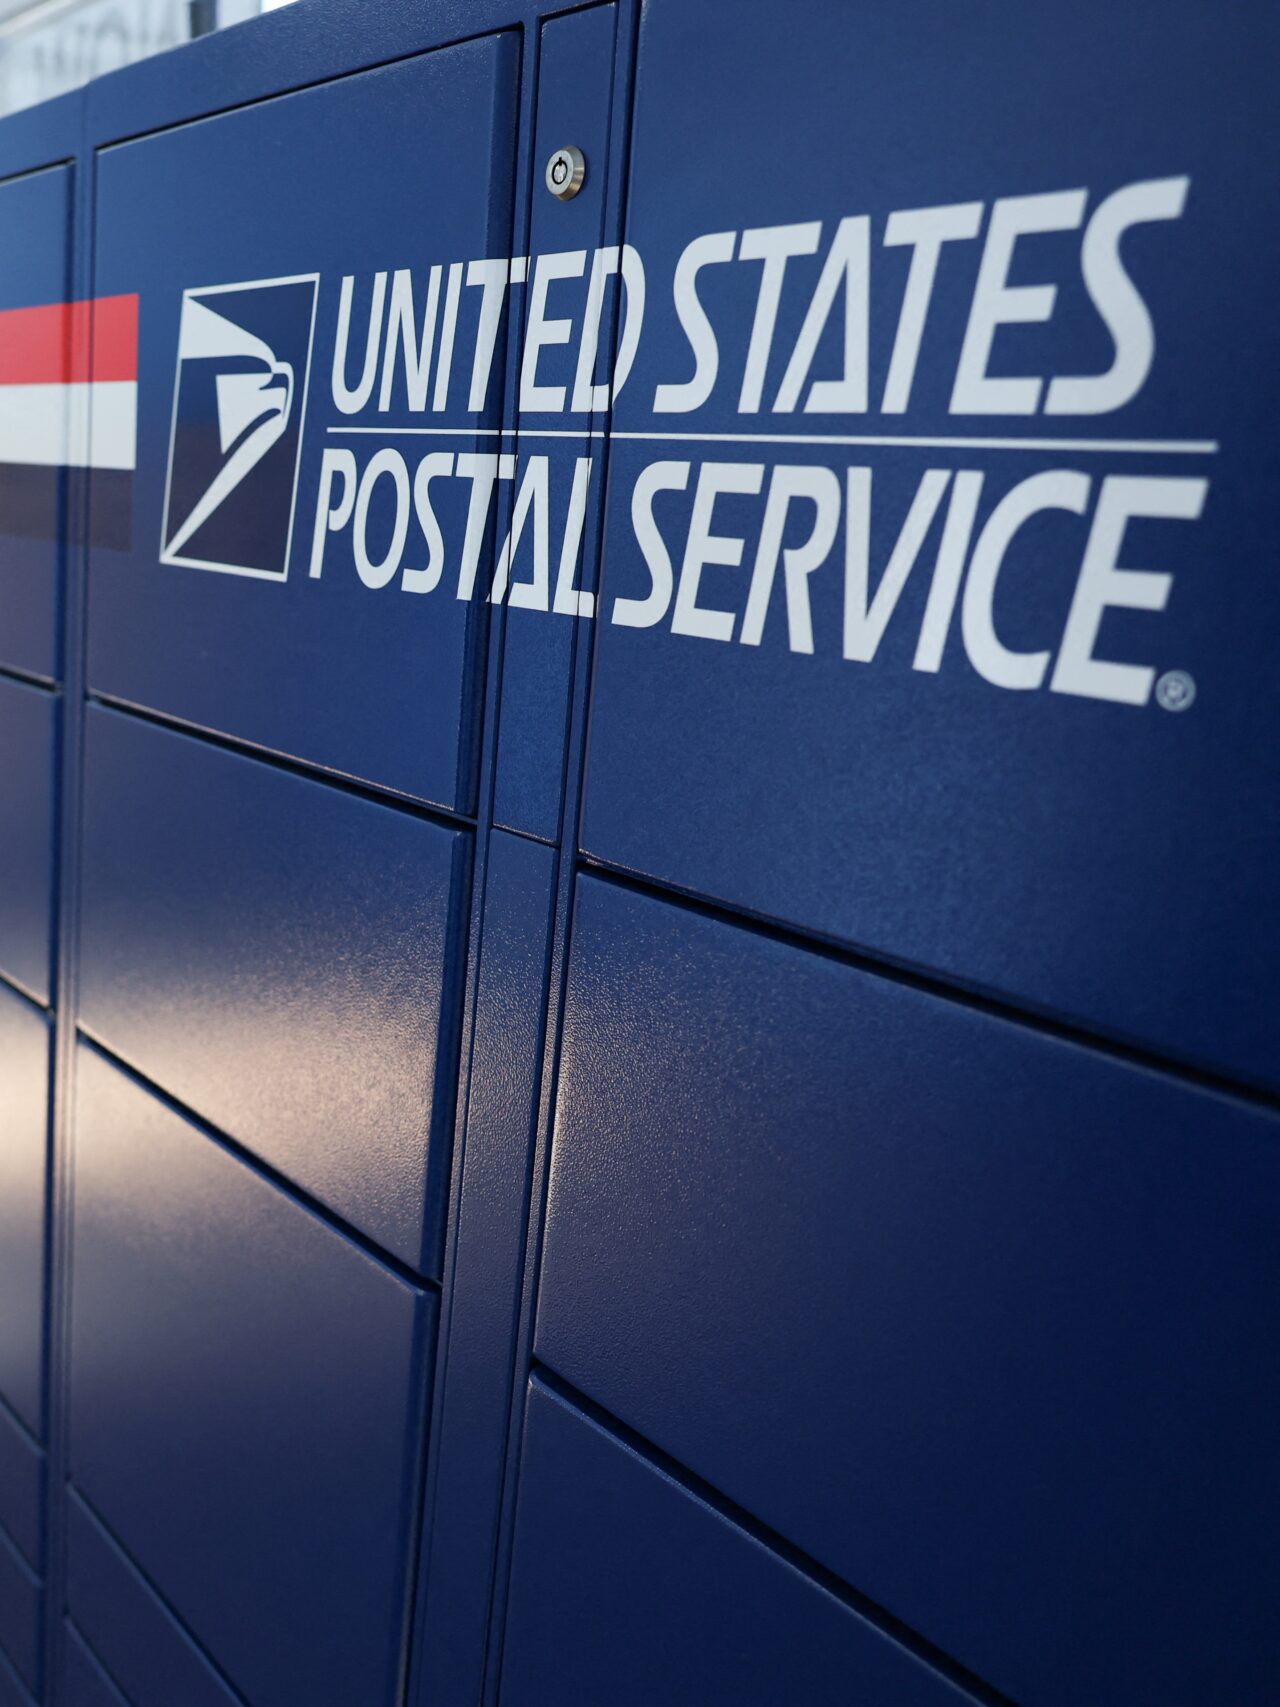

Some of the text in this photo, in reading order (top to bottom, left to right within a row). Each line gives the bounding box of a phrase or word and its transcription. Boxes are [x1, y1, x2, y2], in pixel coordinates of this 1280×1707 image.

[330, 175, 1190, 416] UNITED STATES
[309, 447, 597, 620] POSTAL
